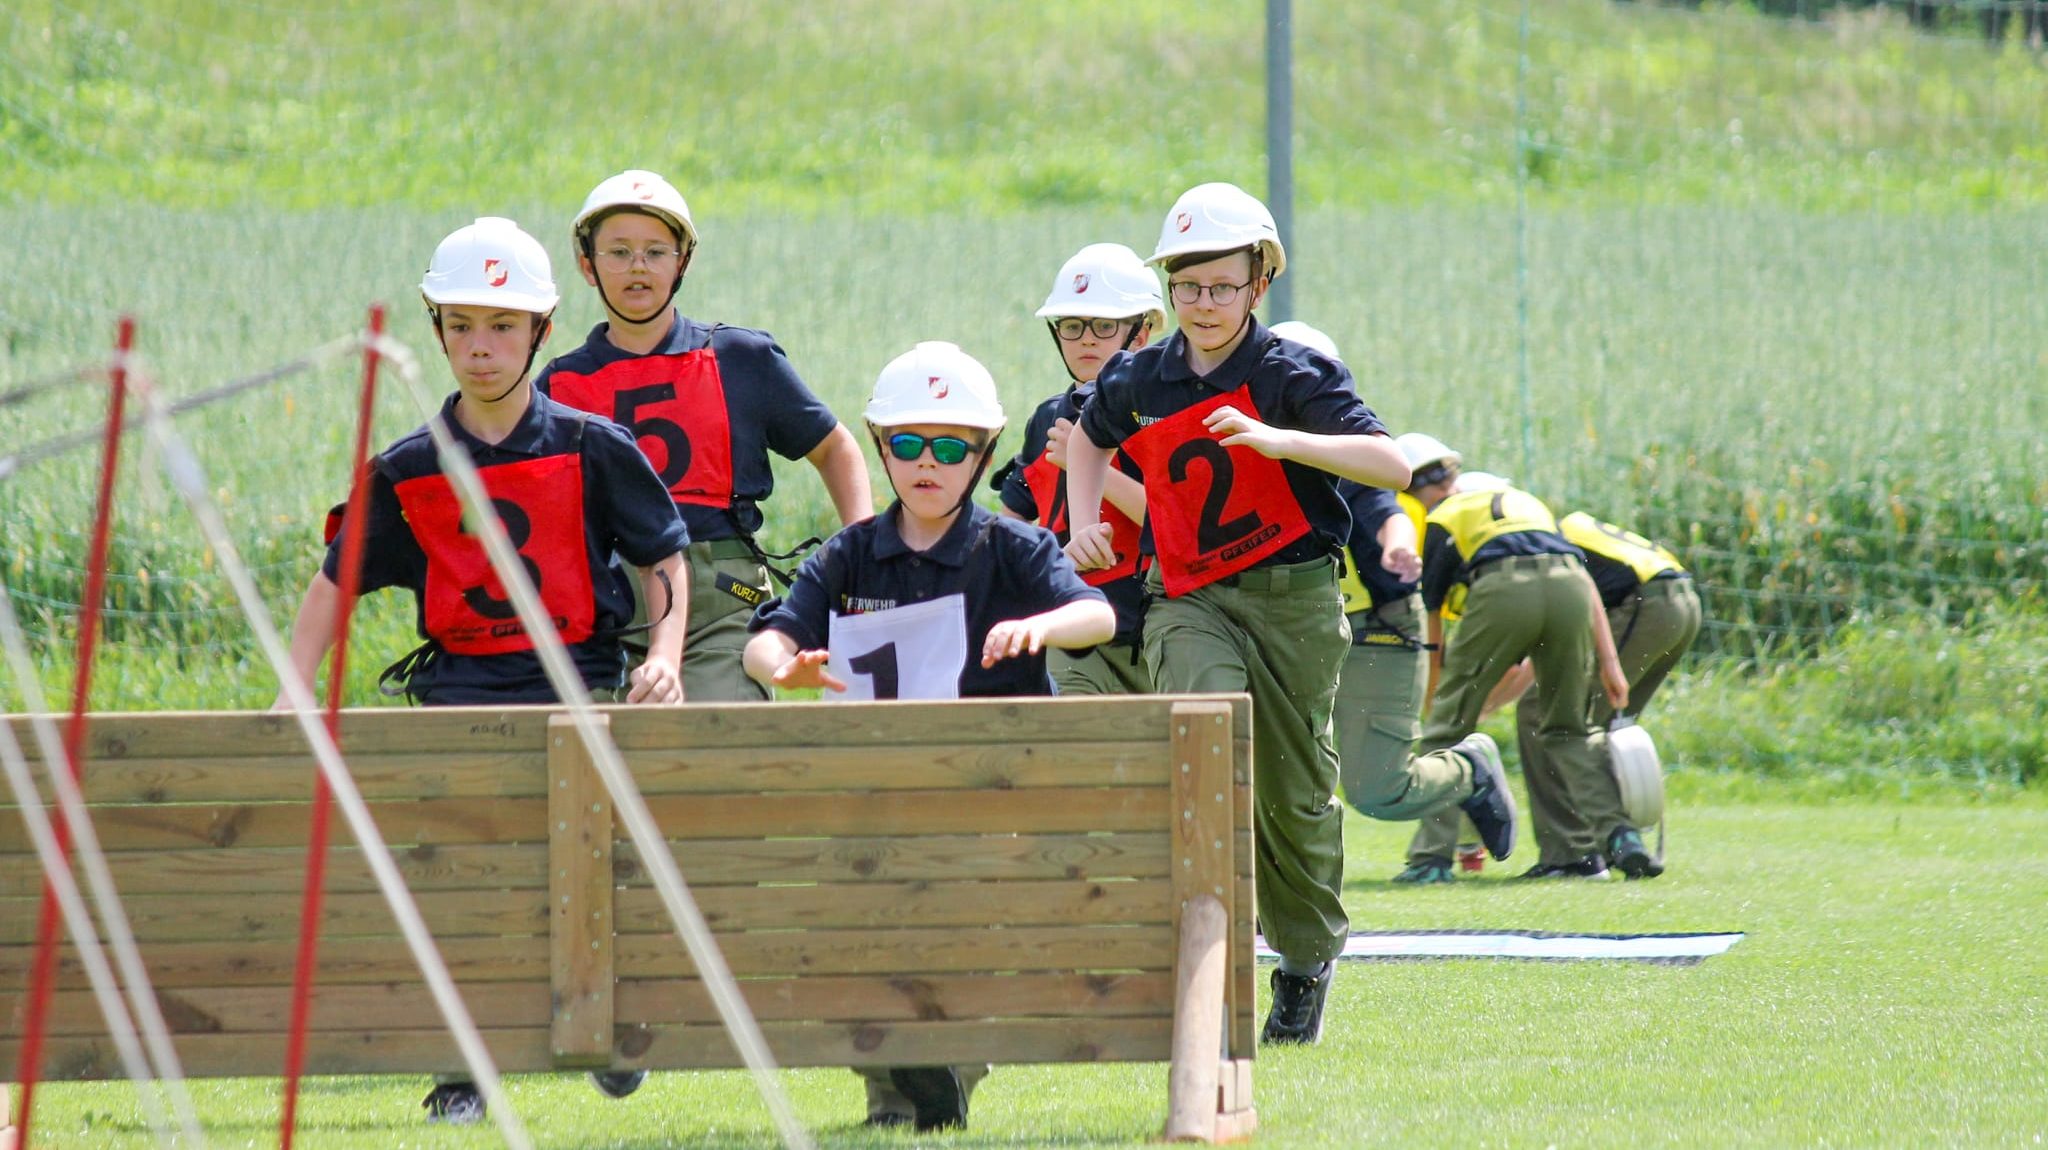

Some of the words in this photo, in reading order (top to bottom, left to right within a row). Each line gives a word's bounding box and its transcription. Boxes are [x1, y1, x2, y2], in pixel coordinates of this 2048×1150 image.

[613, 382, 691, 489] 5
[1168, 437, 1264, 556] 2
[1222, 525, 1279, 560] PFEIFER
[458, 497, 542, 620] 3
[848, 641, 899, 700] 1
